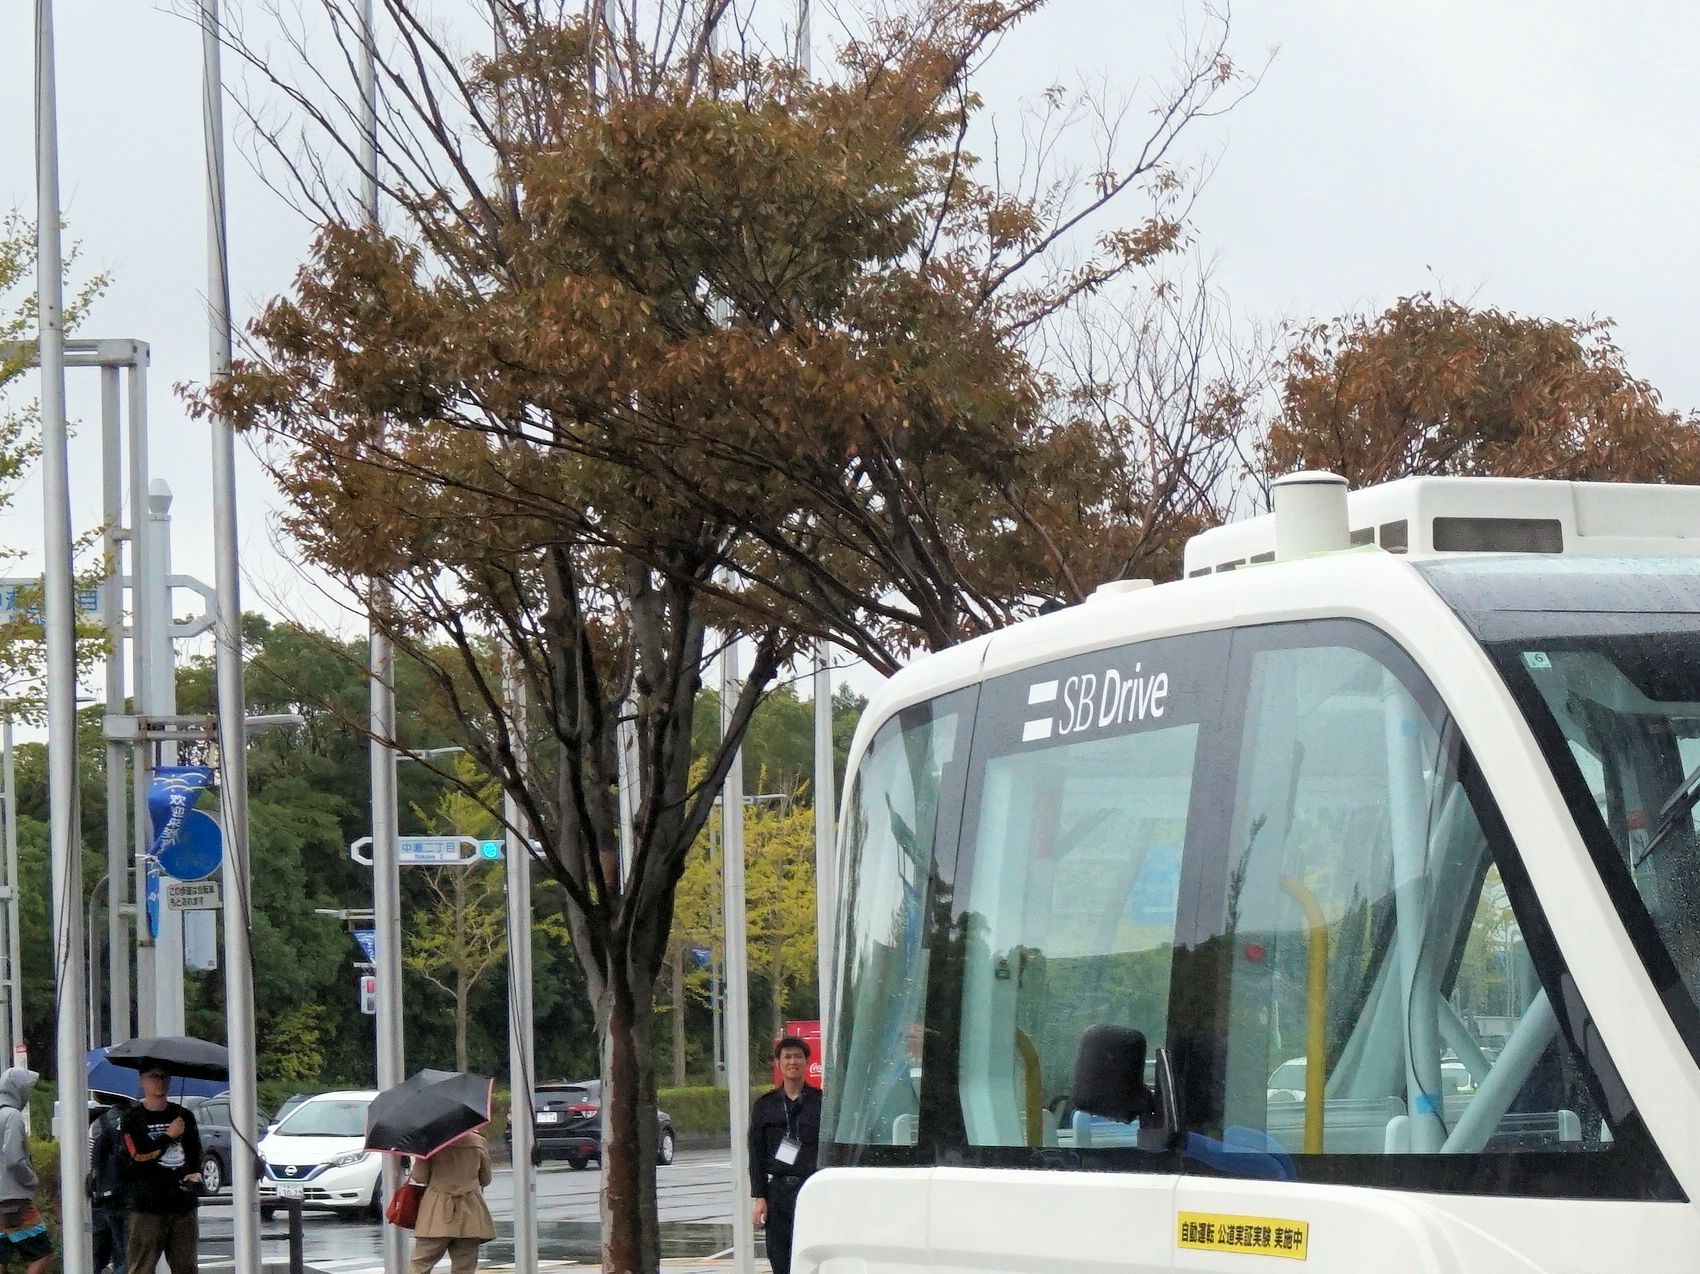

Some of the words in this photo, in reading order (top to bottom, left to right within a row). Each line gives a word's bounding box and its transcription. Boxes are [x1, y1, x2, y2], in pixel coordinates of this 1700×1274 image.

[1058, 673, 1097, 735] SB
[1098, 662, 1169, 728] Drive
[1181, 1220, 1215, 1244] 自動運転
[1217, 1223, 1272, 1248] 公道実証実験
[1274, 1226, 1303, 1250] 実施中
